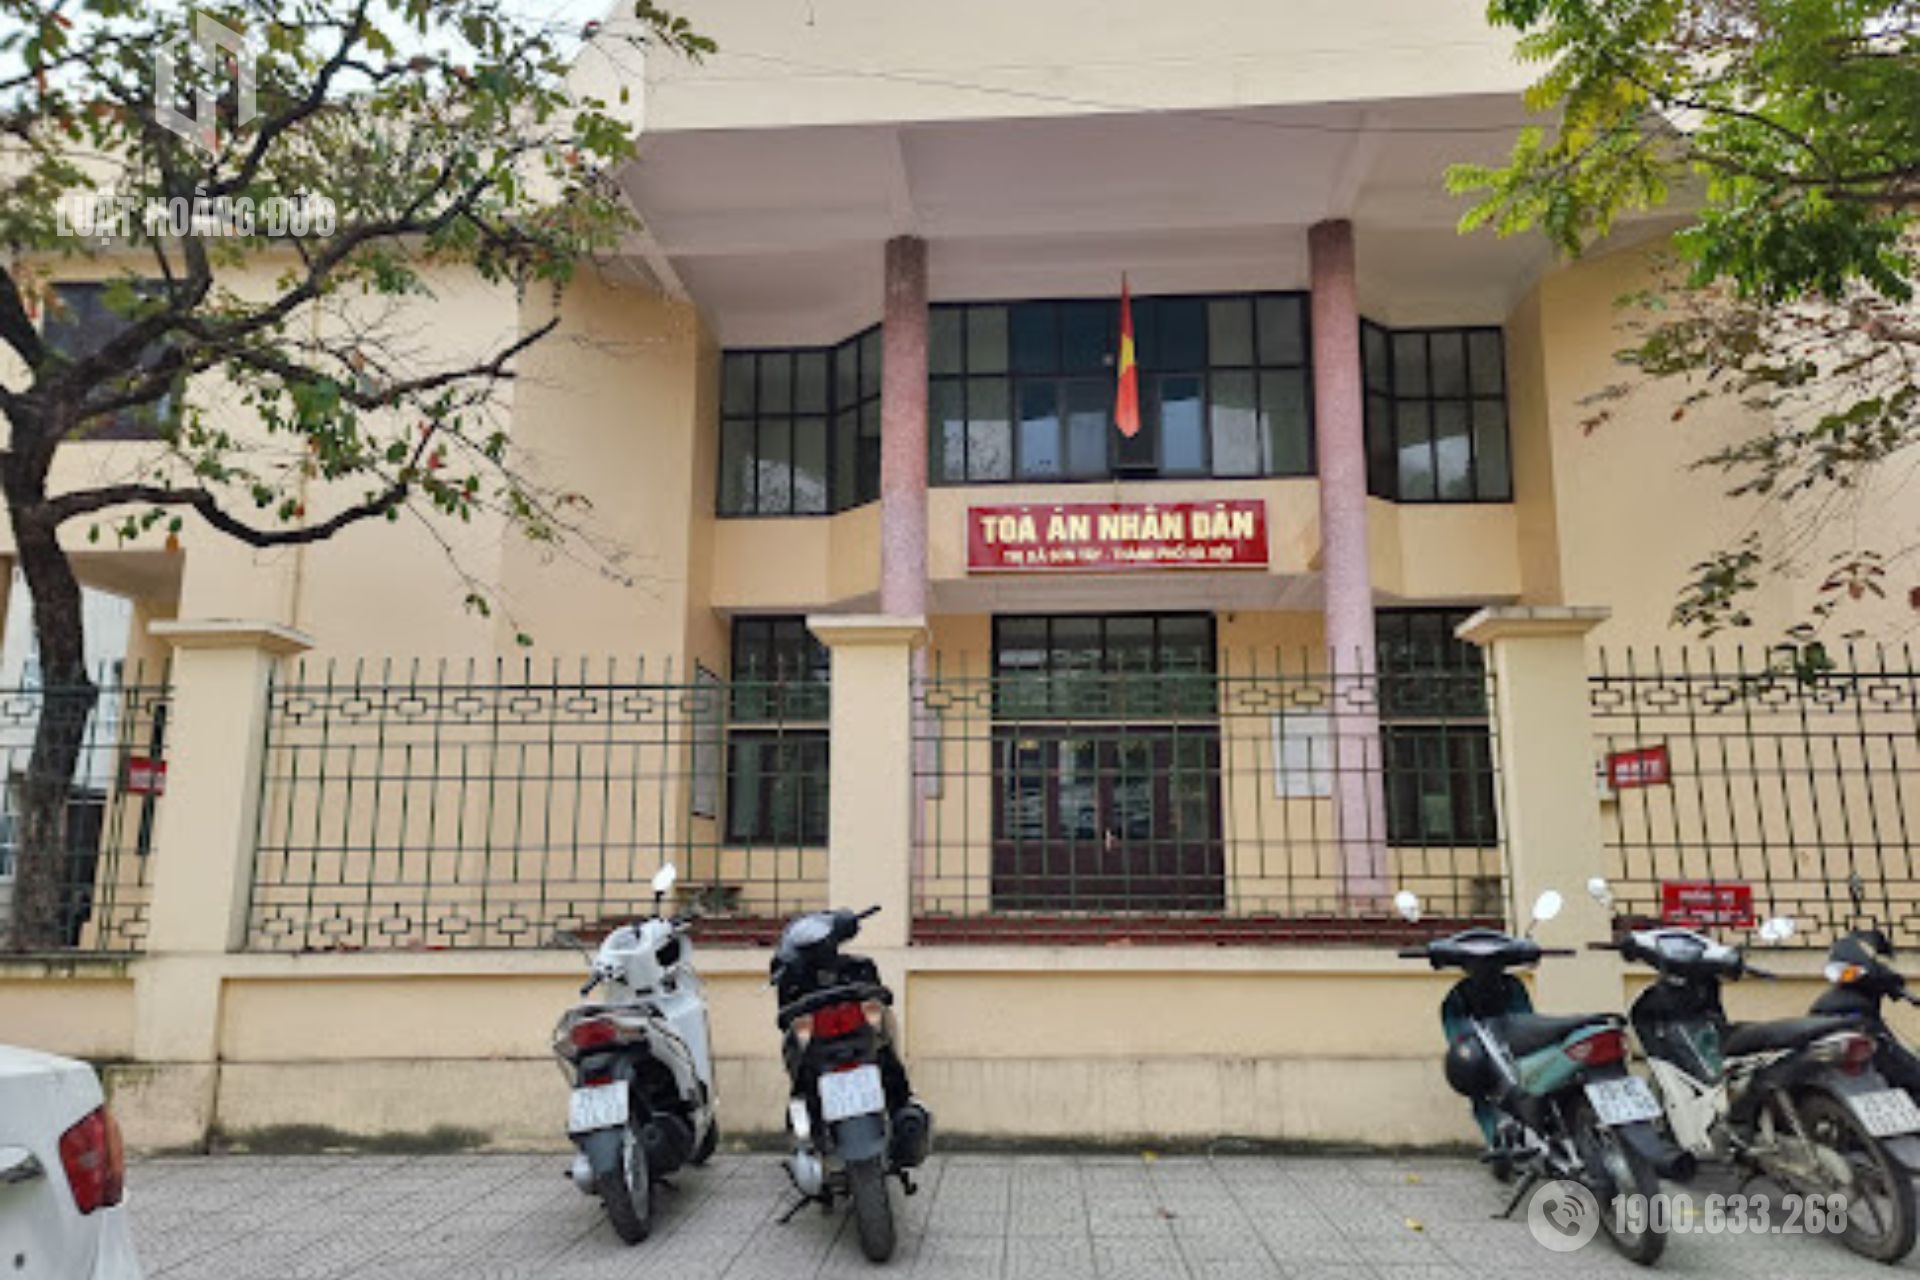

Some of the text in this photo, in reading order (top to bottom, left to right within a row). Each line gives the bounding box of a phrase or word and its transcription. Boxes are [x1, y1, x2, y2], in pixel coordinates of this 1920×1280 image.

[1047, 505, 1091, 542] ÁN
[1098, 504, 1183, 540] NHÂN
[1191, 503, 1254, 538] DÂN
